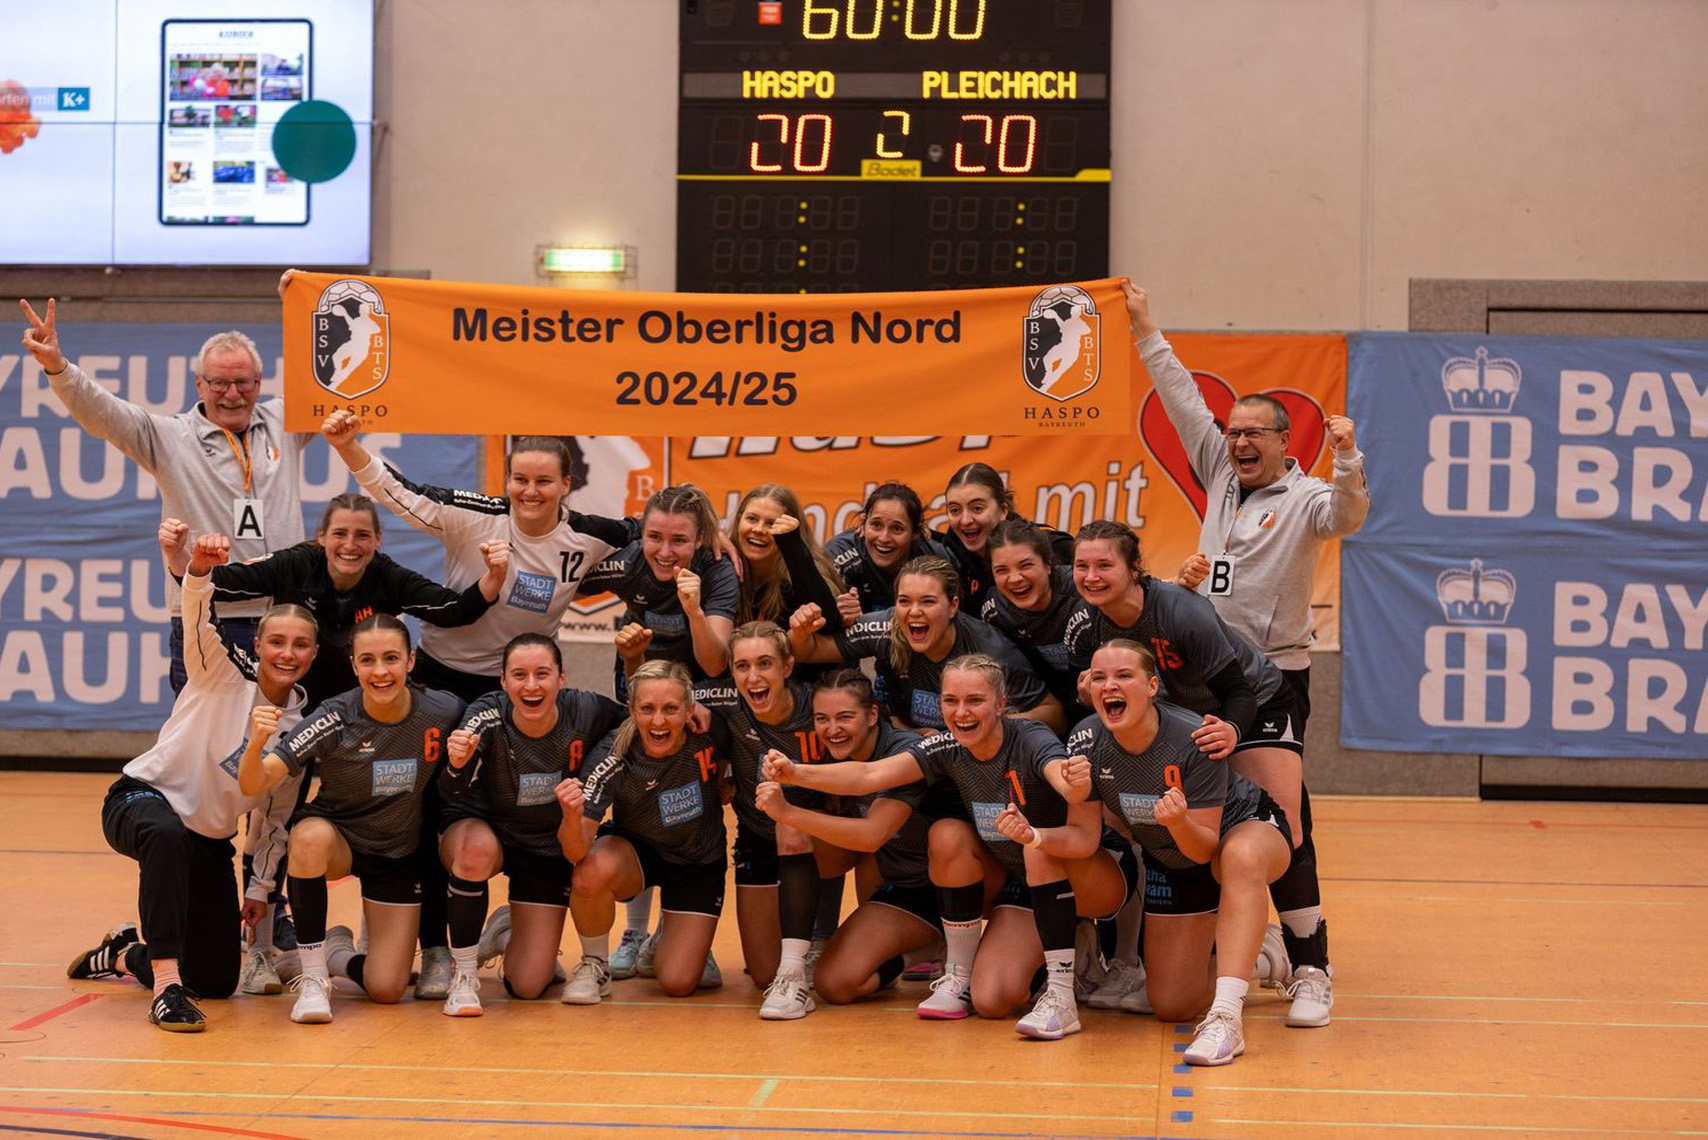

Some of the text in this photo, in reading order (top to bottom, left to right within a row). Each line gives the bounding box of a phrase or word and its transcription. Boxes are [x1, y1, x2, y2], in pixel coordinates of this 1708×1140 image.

[742, 70, 835, 99] HASPO
[923, 70, 1077, 99] PLEICHACH
[750, 113, 833, 173] 20
[876, 110, 911, 158] 2
[955, 113, 1037, 173] 20
[452, 307, 962, 353] Meister Oberliga Nord
[615, 371, 798, 407] 2024/25
[1023, 406, 1101, 419] HASPO
[1034, 460, 1149, 533] mit
[1555, 444, 1708, 523] BR
[237, 504, 263, 537] A
[518, 574, 554, 590] STADT
[559, 551, 585, 583] 12
[1210, 560, 1231, 593] B
[514, 584, 552, 601] WERKE
[1150, 637, 1185, 671] 15
[1551, 656, 1708, 735] BR
[424, 726, 441, 762] 6
[375, 762, 414, 775] STADT
[1163, 764, 1183, 792] 9
[660, 784, 698, 804] STADT
[662, 795, 700, 815] WERKE
